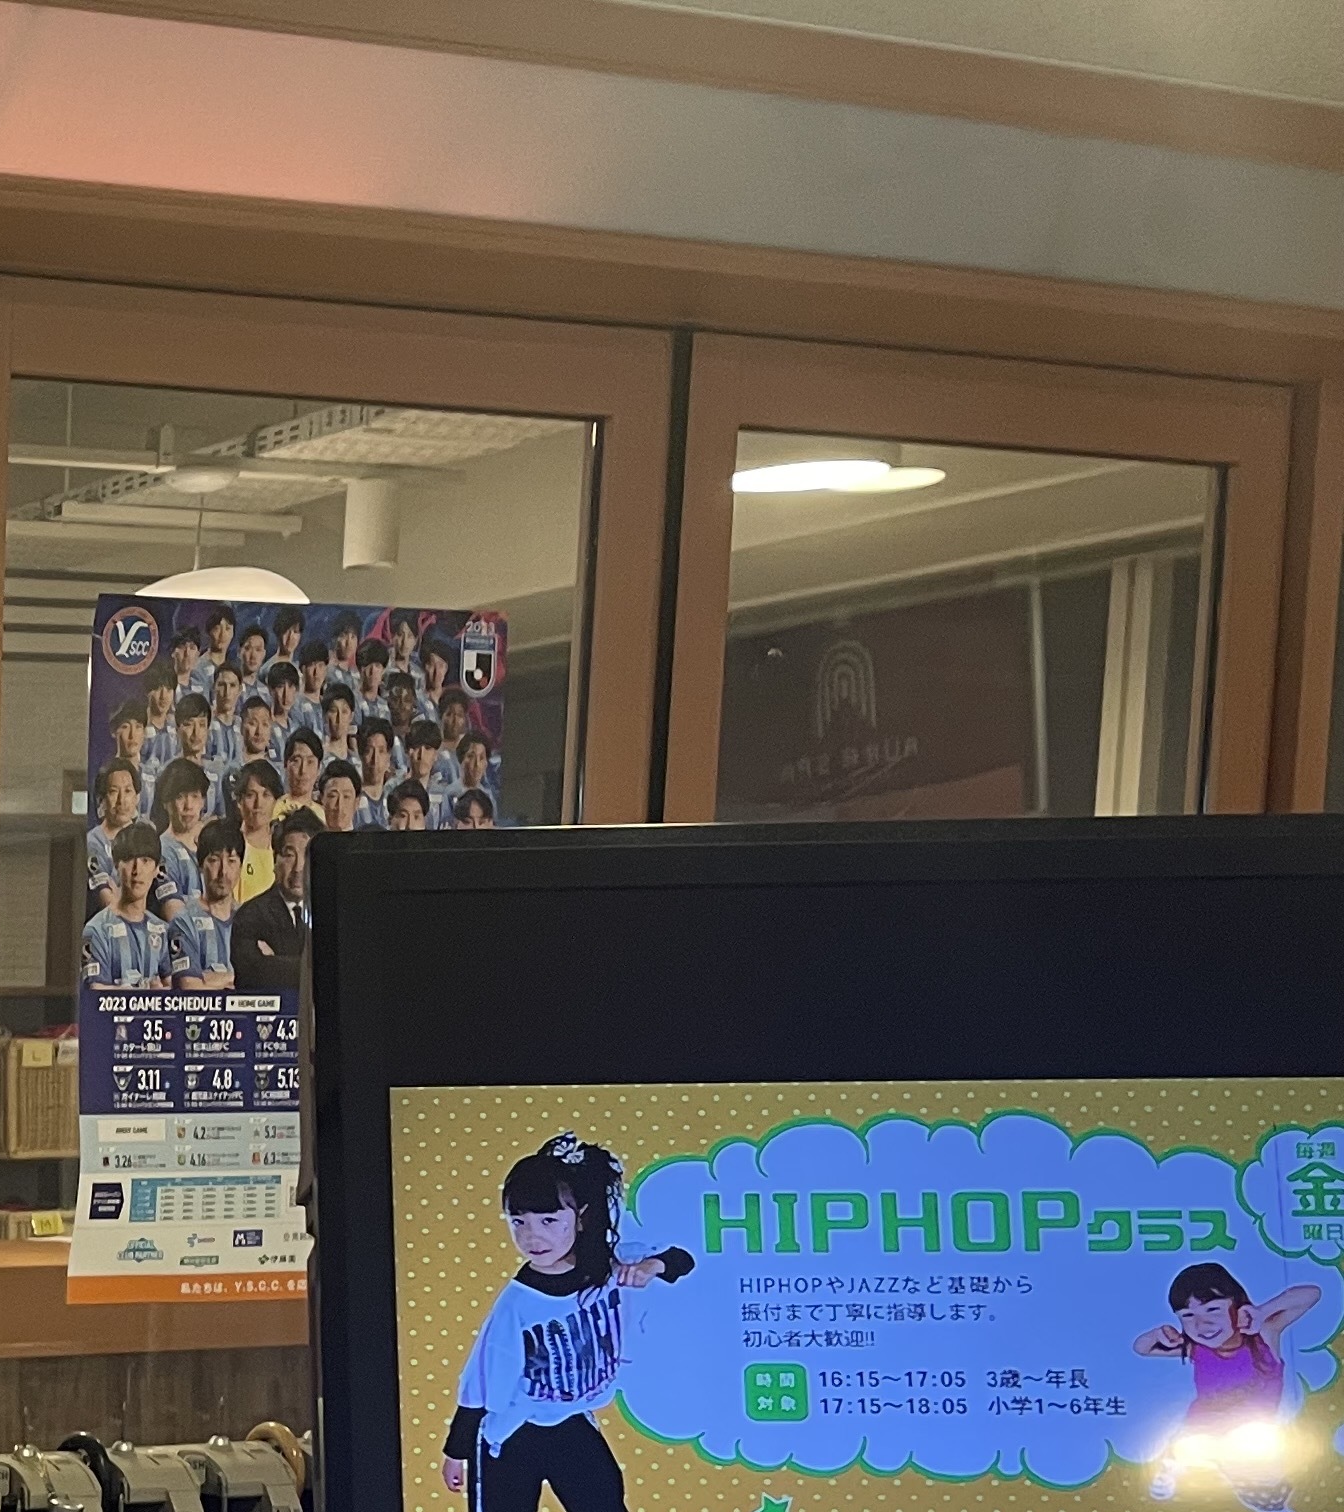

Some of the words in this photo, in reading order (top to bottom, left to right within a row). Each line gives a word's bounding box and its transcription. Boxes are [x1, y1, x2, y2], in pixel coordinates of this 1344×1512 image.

[98, 996, 127, 1012] 2023
[129, 996, 162, 1012] GAME
[164, 996, 223, 1011] SCHEDULE
[143, 1019, 163, 1041] 3.5
[209, 1019, 235, 1041] 3.19
[137, 1069, 161, 1091] 3.11
[212, 1069, 233, 1090] 4.8
[1286, 1162, 1344, 1218] 金
[739, 1274, 1034, 1295] HIPHOPやJAZZなど基礎から
[740, 1303, 998, 1323] 振付まで丁寧に指導します。
[817, 1370, 968, 1389] 16:15～17:05
[986, 1369, 1090, 1390] 3歳～年長
[819, 1397, 969, 1416] 17:15～18:05
[987, 1396, 1128, 1417] 小学1～6年生
